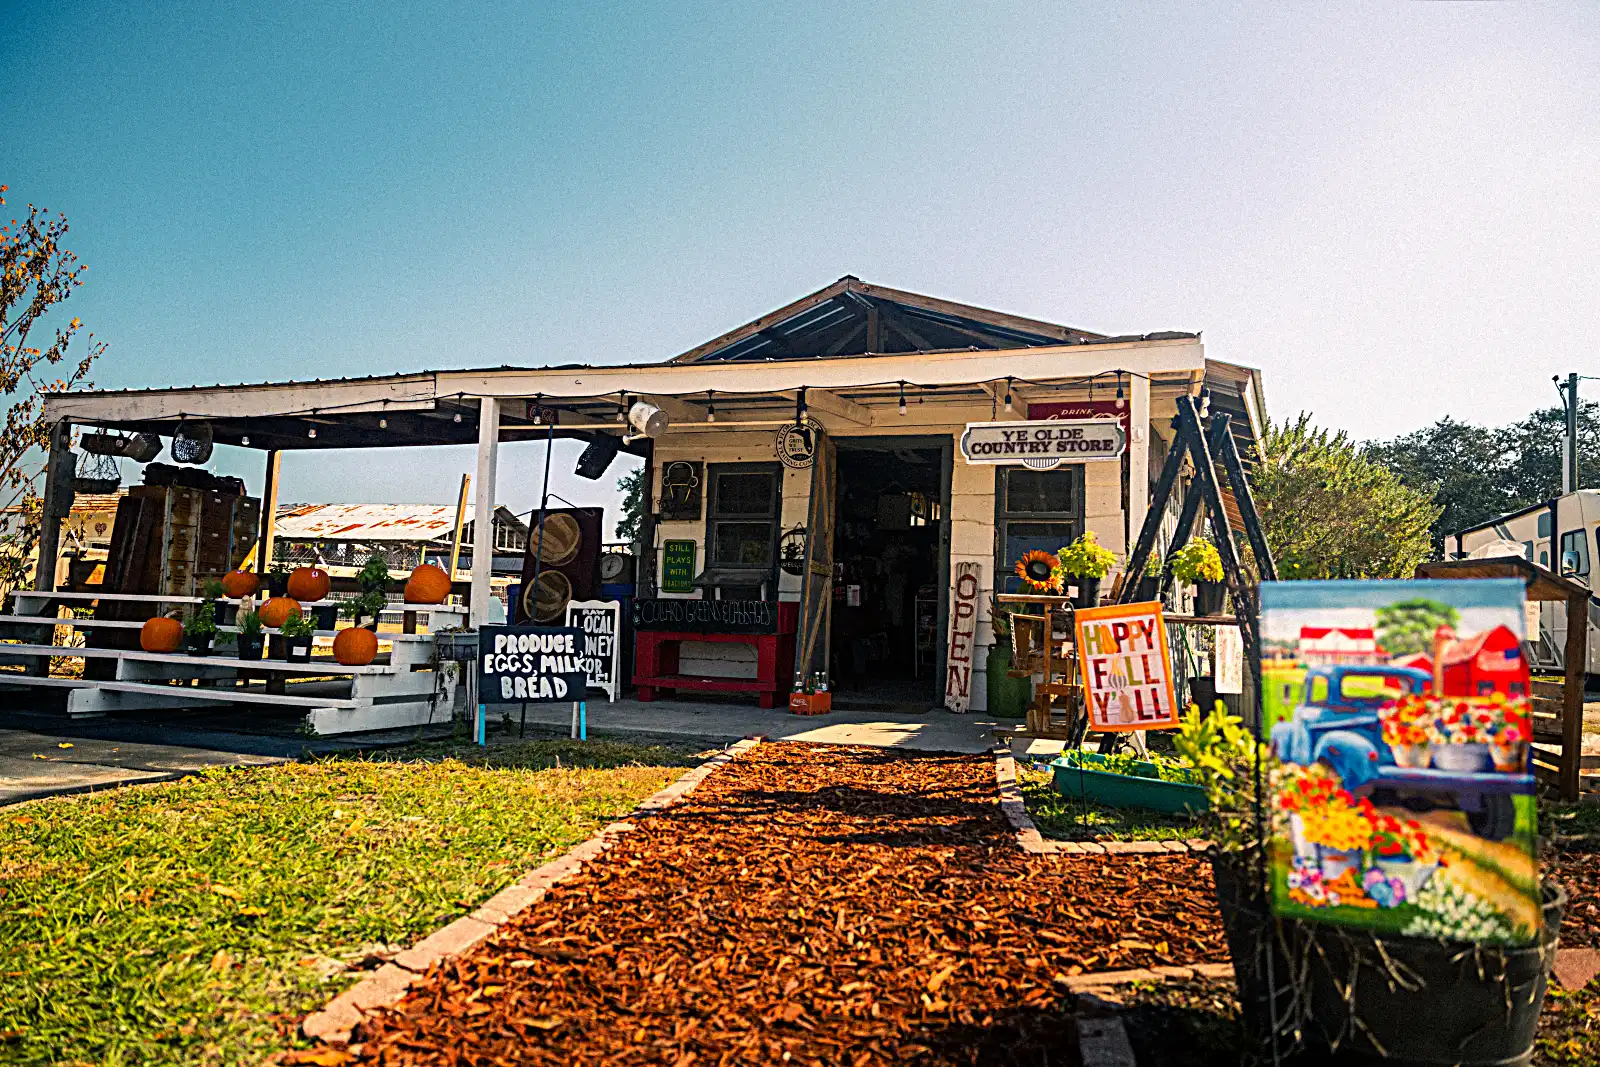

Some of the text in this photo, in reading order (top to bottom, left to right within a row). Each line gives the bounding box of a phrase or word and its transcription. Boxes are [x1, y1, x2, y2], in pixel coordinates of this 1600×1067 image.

[1061, 408, 1094, 416] DRINK
[1001, 428, 1084, 442] YE OLDE
[971, 439, 1114, 455] COUNTRY STORE
[669, 544, 690, 552] STILL
[666, 556, 691, 564] PLAYS
[670, 568, 687, 576] WITH
[573, 614, 613, 634] LOCAL
[946, 574, 978, 697] OPEN
[584, 635, 614, 657] NEY
[540, 655, 587, 674] MILK
[584, 658, 603, 674] OR
[587, 672, 609, 684] LE!
[500, 676, 568, 699] BREAD
